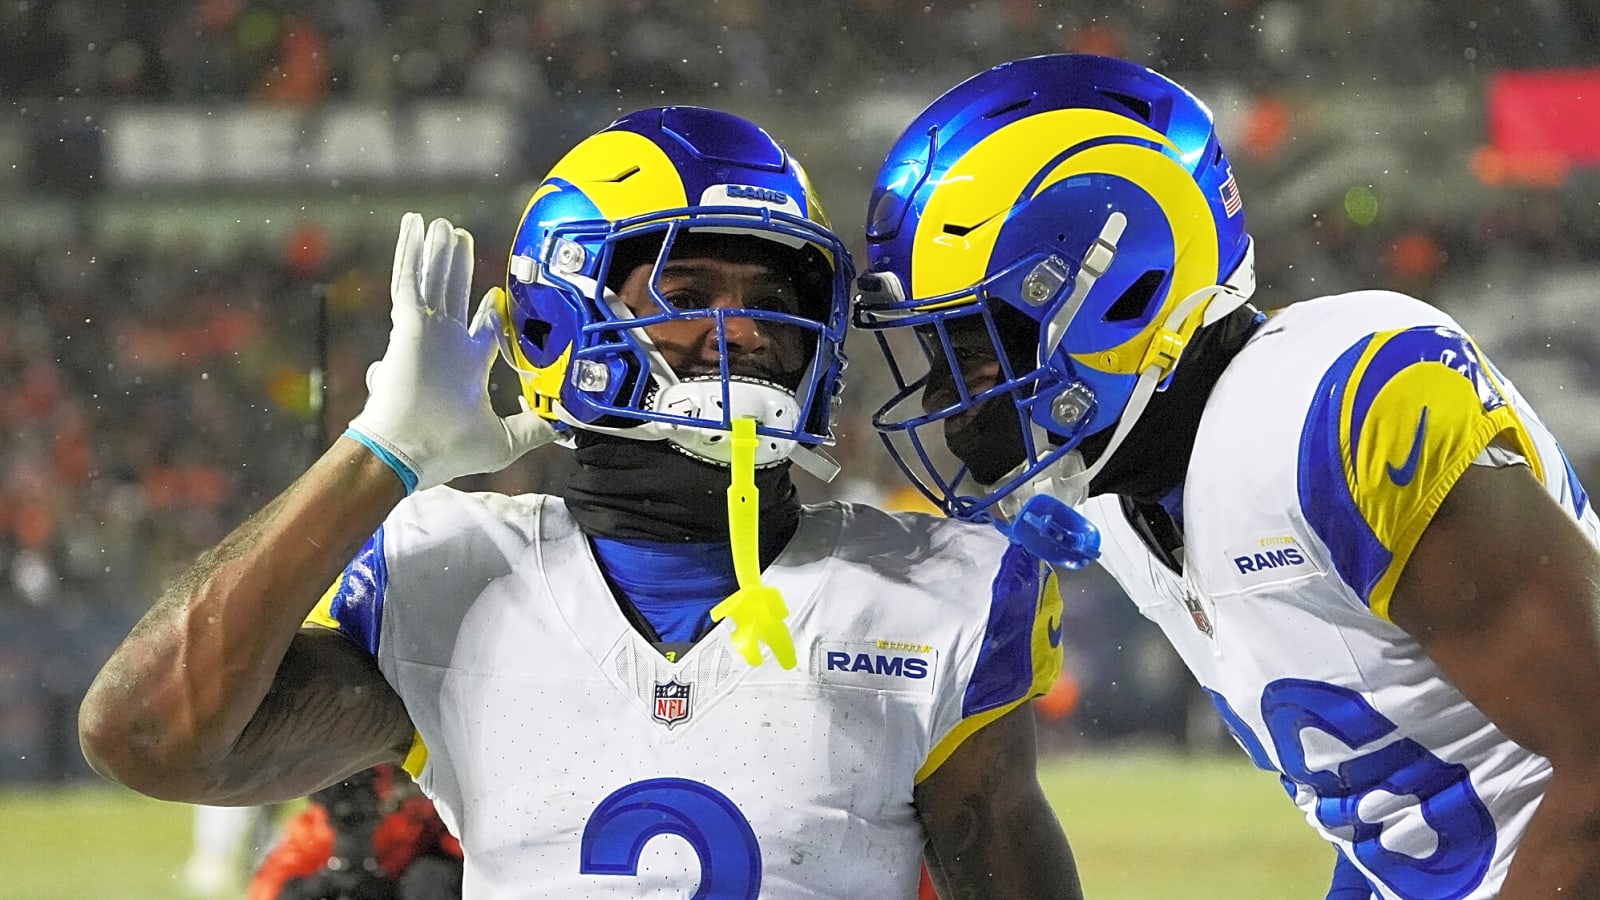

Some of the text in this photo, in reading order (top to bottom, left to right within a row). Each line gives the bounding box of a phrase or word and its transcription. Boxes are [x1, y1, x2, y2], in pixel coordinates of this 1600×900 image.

[726, 185, 788, 204] RAMS
[1233, 548, 1305, 575] RAMS
[827, 651, 929, 679] RAMS
[657, 699, 685, 719] NFL
